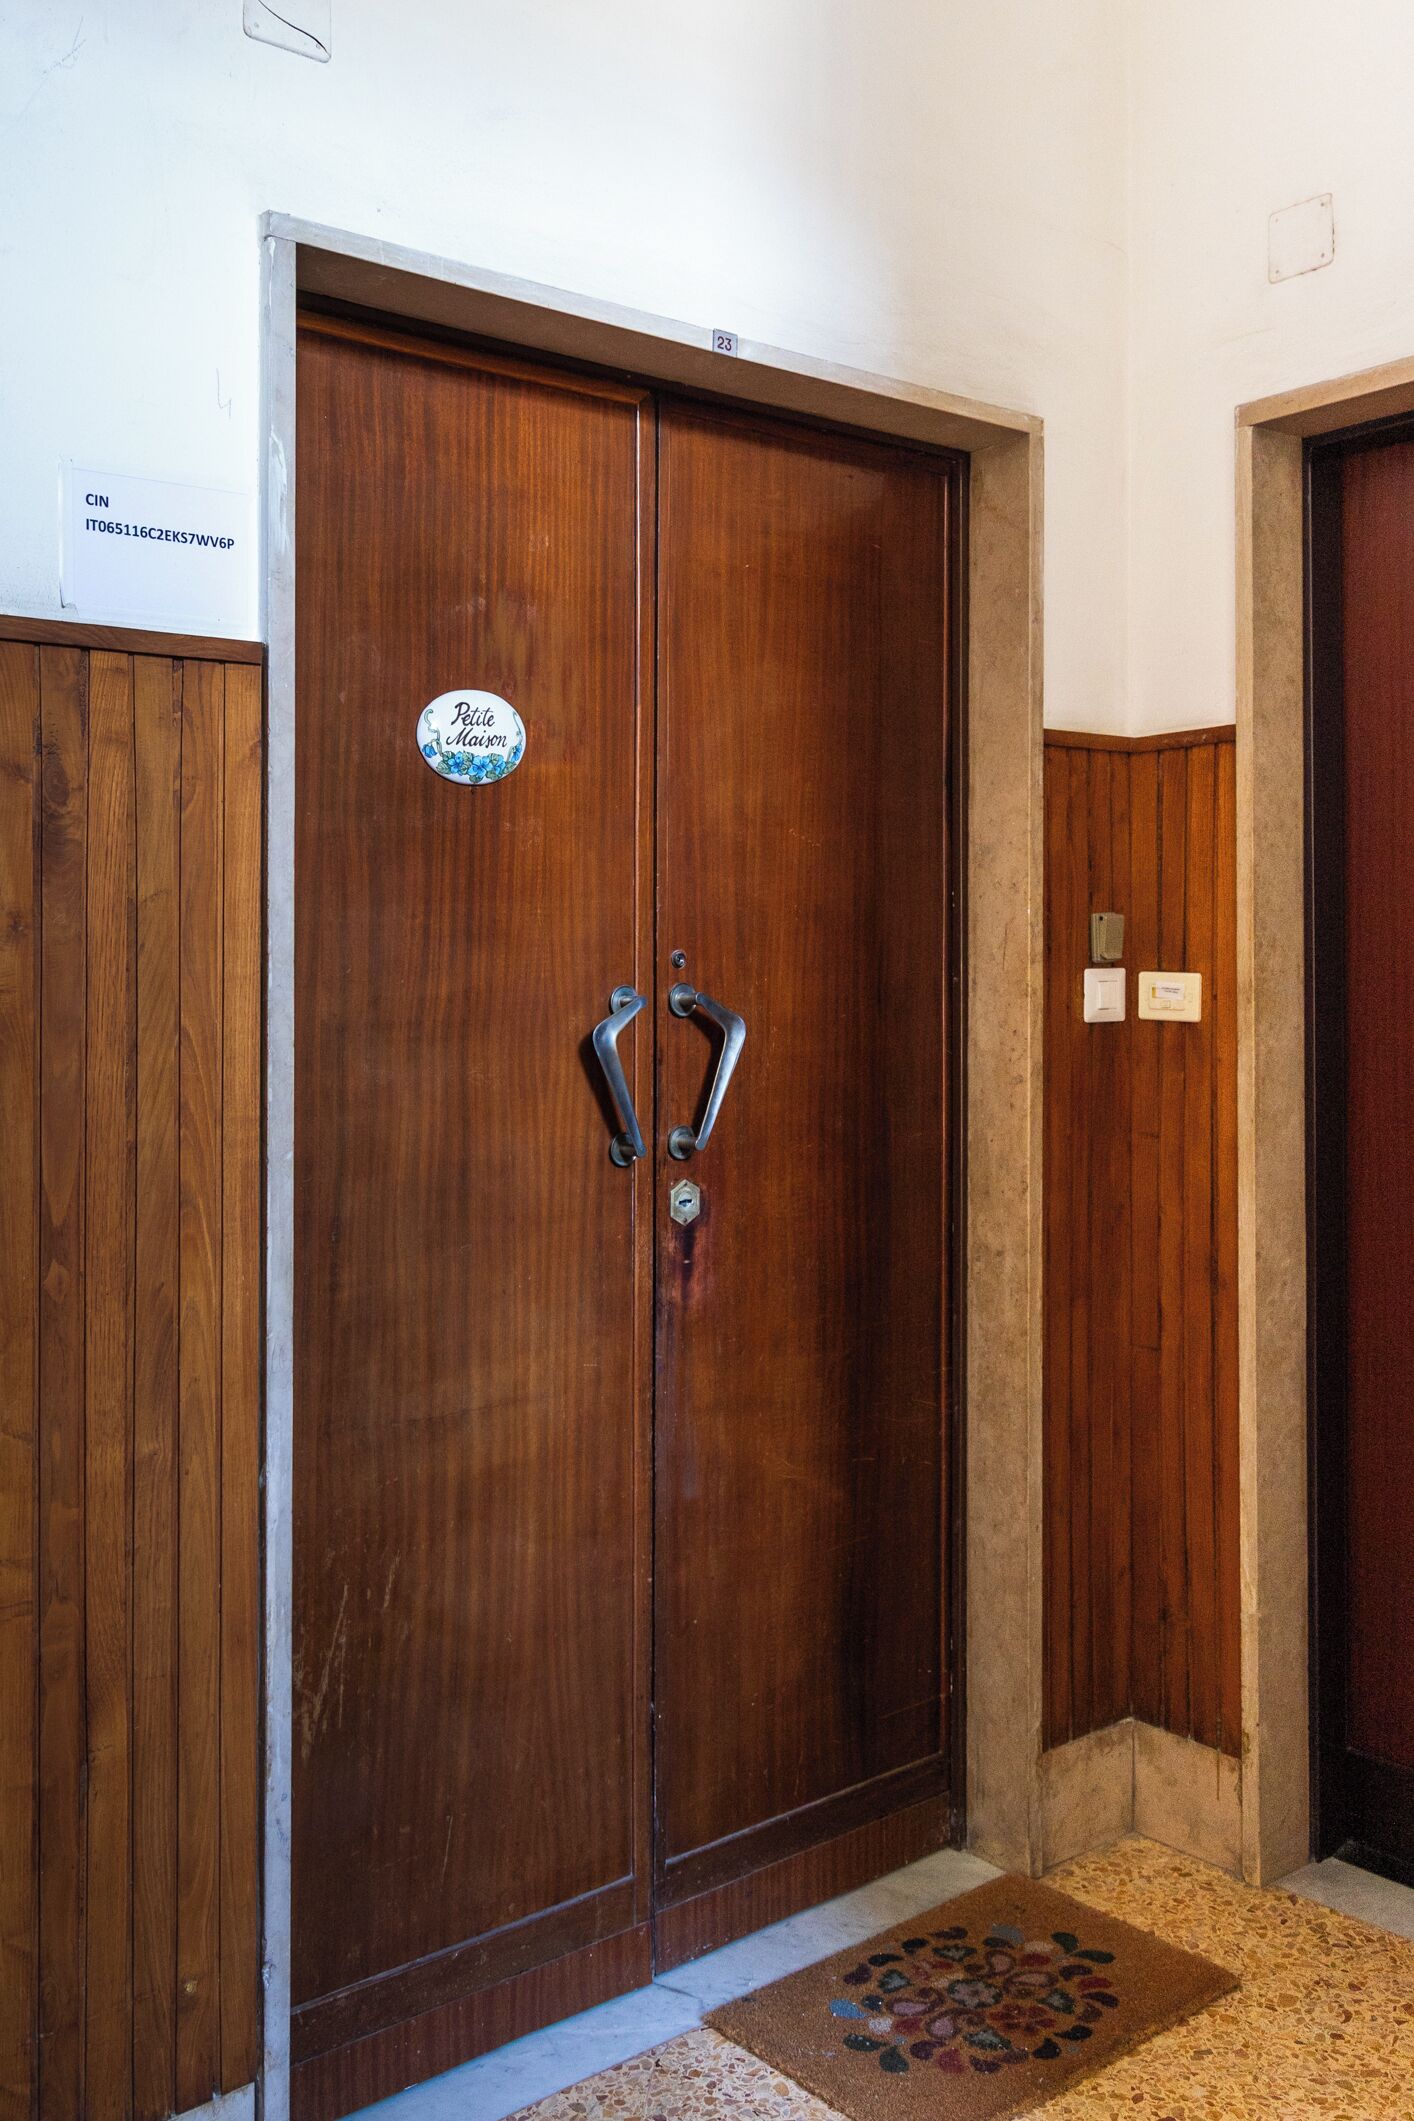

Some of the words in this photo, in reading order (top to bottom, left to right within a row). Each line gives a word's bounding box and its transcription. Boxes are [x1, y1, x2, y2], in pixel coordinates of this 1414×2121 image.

[717, 336, 732, 351] 23
[85, 493, 109, 508] CIN
[85, 518, 235, 549] IT065116C2EKS7WV6P
[450, 701, 495, 727] Petite
[445, 727, 508, 748] Maison
